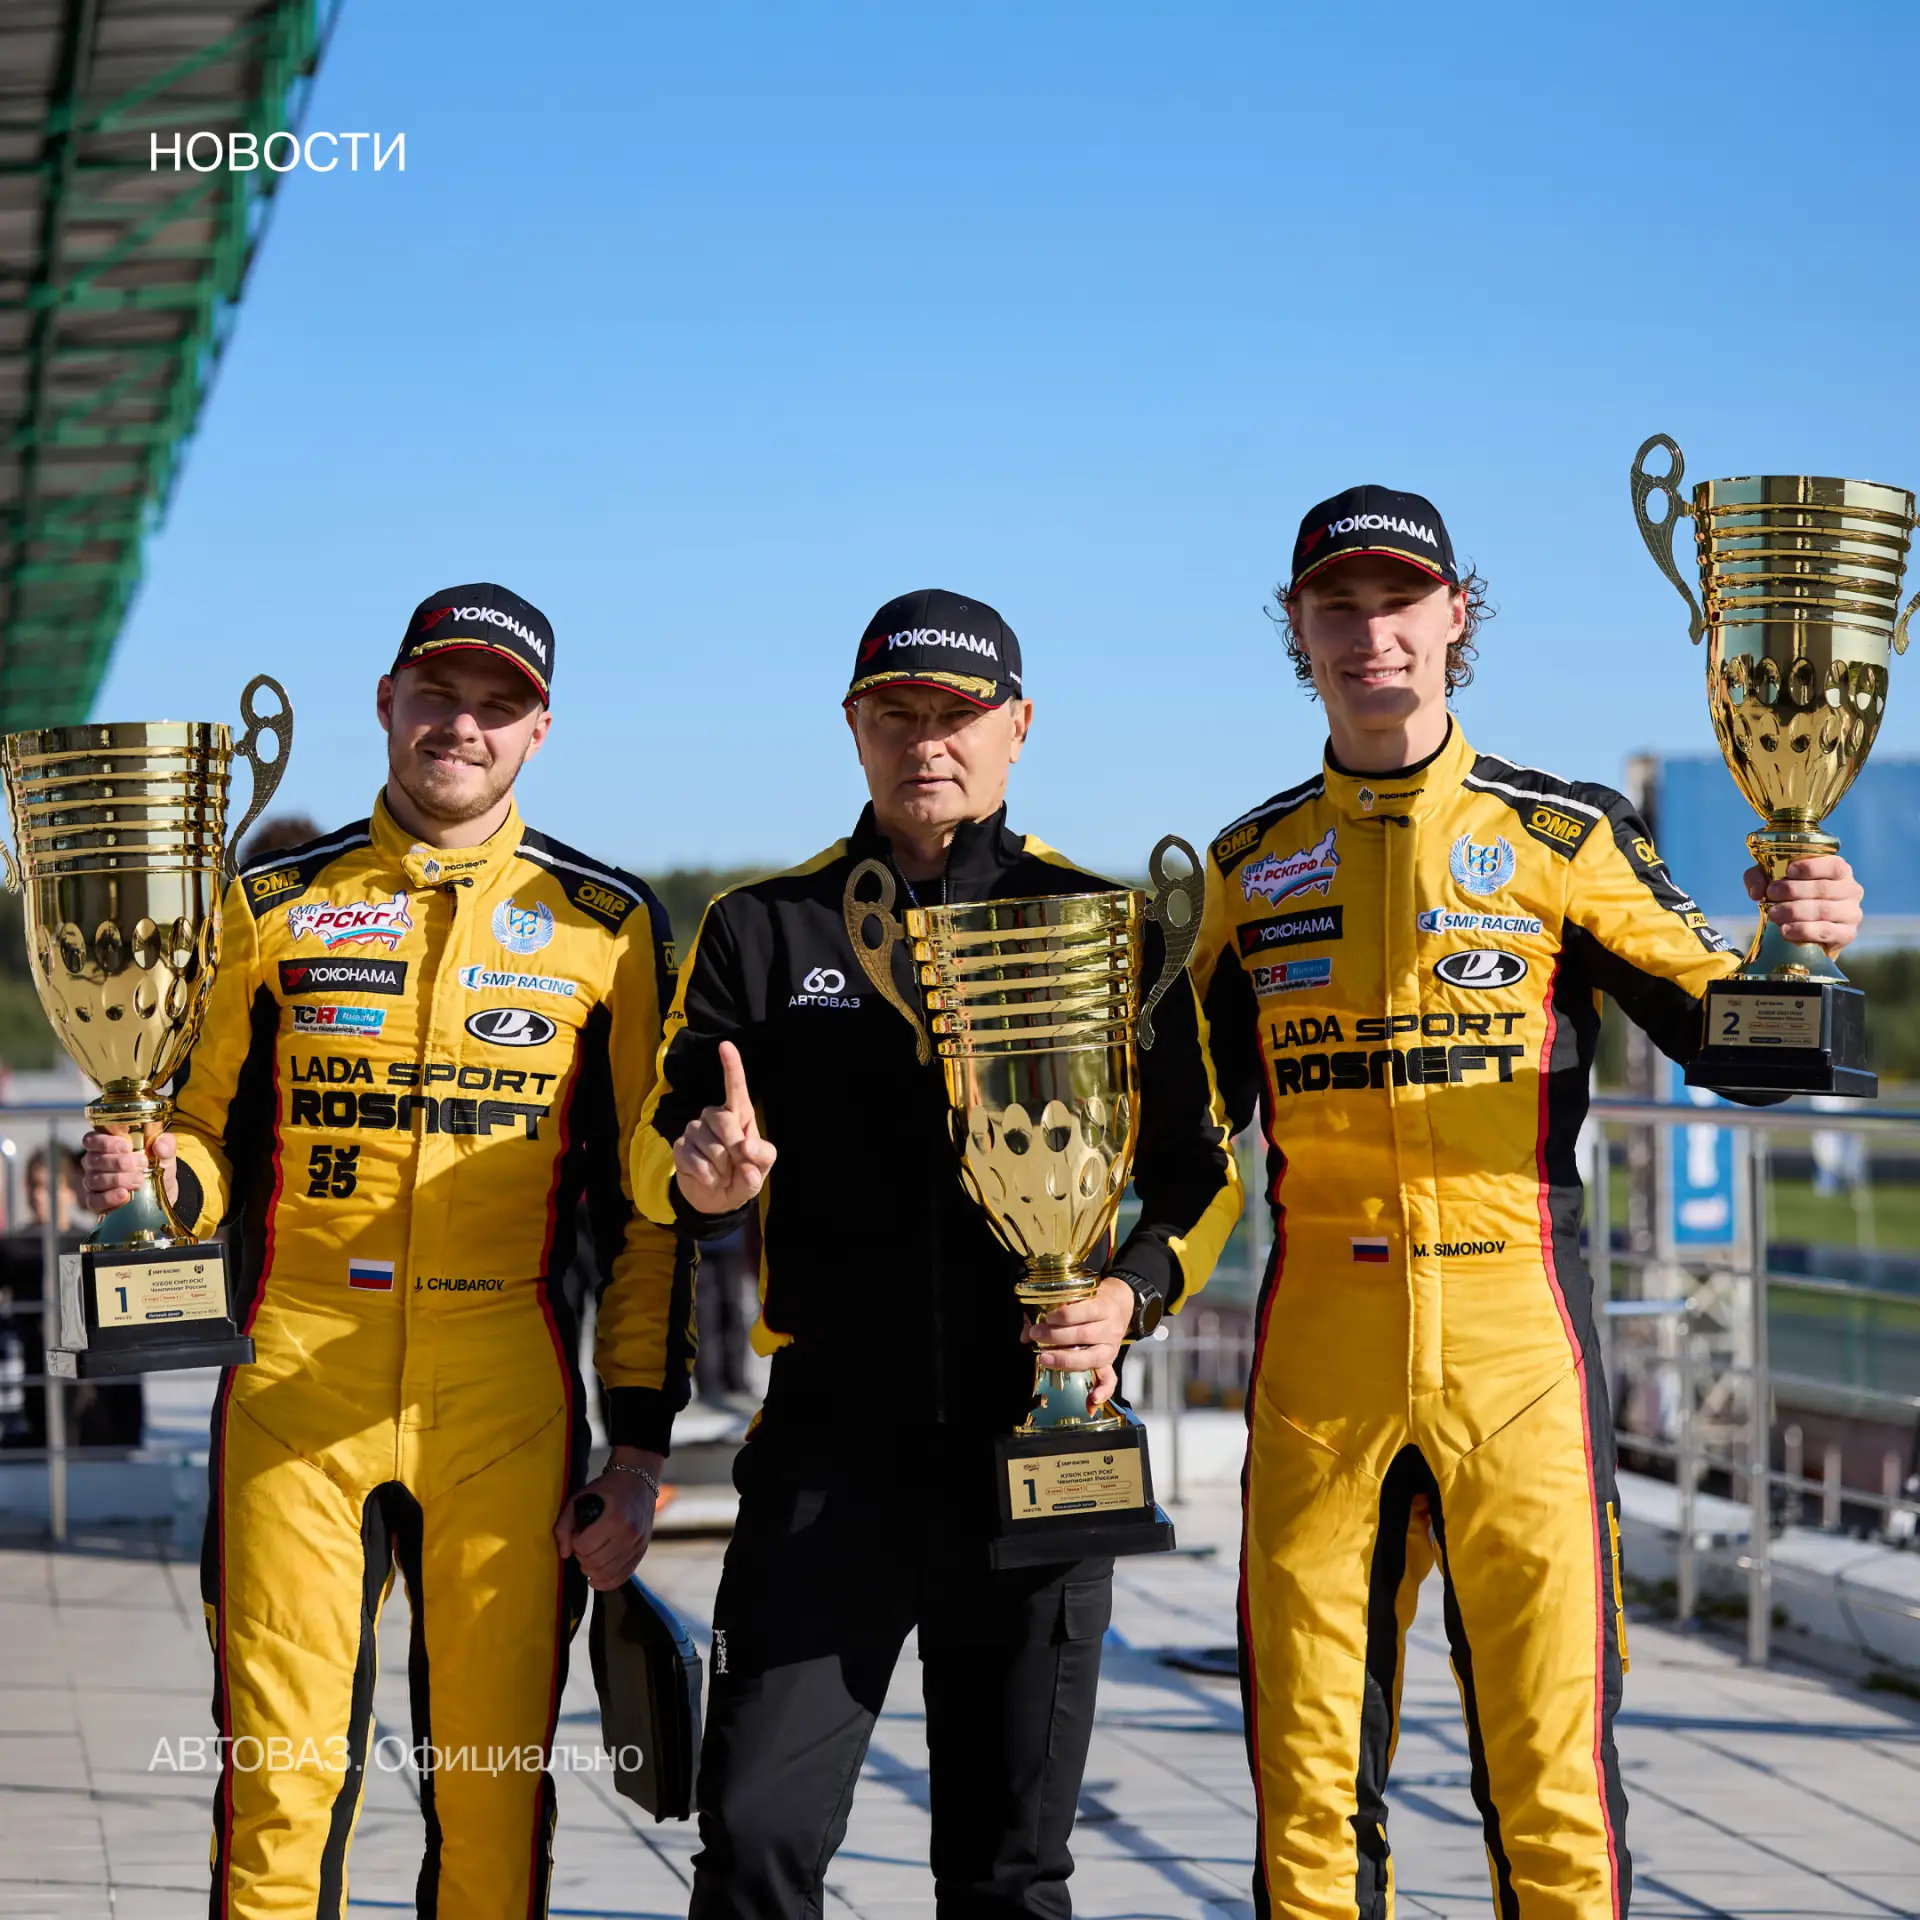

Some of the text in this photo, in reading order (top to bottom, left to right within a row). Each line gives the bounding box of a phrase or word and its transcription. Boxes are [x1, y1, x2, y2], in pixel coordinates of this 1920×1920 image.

[1328, 514, 1438, 548] YOKOHAMA
[452, 607, 547, 665] YOKOHAMA
[888, 628, 998, 661] YOKOHAMA
[1532, 810, 1582, 841] OMP
[1216, 824, 1260, 857] OMP
[253, 871, 300, 896] OMP
[1264, 859, 1318, 882] РСКГ.РФ
[578, 885, 626, 914] OMP
[314, 911, 392, 929] РСКГ
[1260, 916, 1335, 942] YOKOHAMA
[1443, 914, 1542, 934] SMP RACING
[309, 967, 397, 985] YOKOHAMA
[481, 972, 576, 996] SMP RACING
[1252, 964, 1288, 988] TCR
[292, 1005, 338, 1025] TCR
[788, 995, 861, 1009] АВТОВАЗ
[1271, 1012, 1526, 1050] LADA SPORT
[1722, 1012, 1740, 1036] 2
[291, 1056, 557, 1095] LADA SPORT
[1273, 1044, 1525, 1097] ROSNEFT
[291, 1088, 550, 1141] ROSNEFT
[1413, 1240, 1506, 1258] M. SIMONOV
[427, 1277, 505, 1292] CHUBAROV
[115, 1286, 128, 1313] 1
[1023, 1478, 1037, 1506] 1
